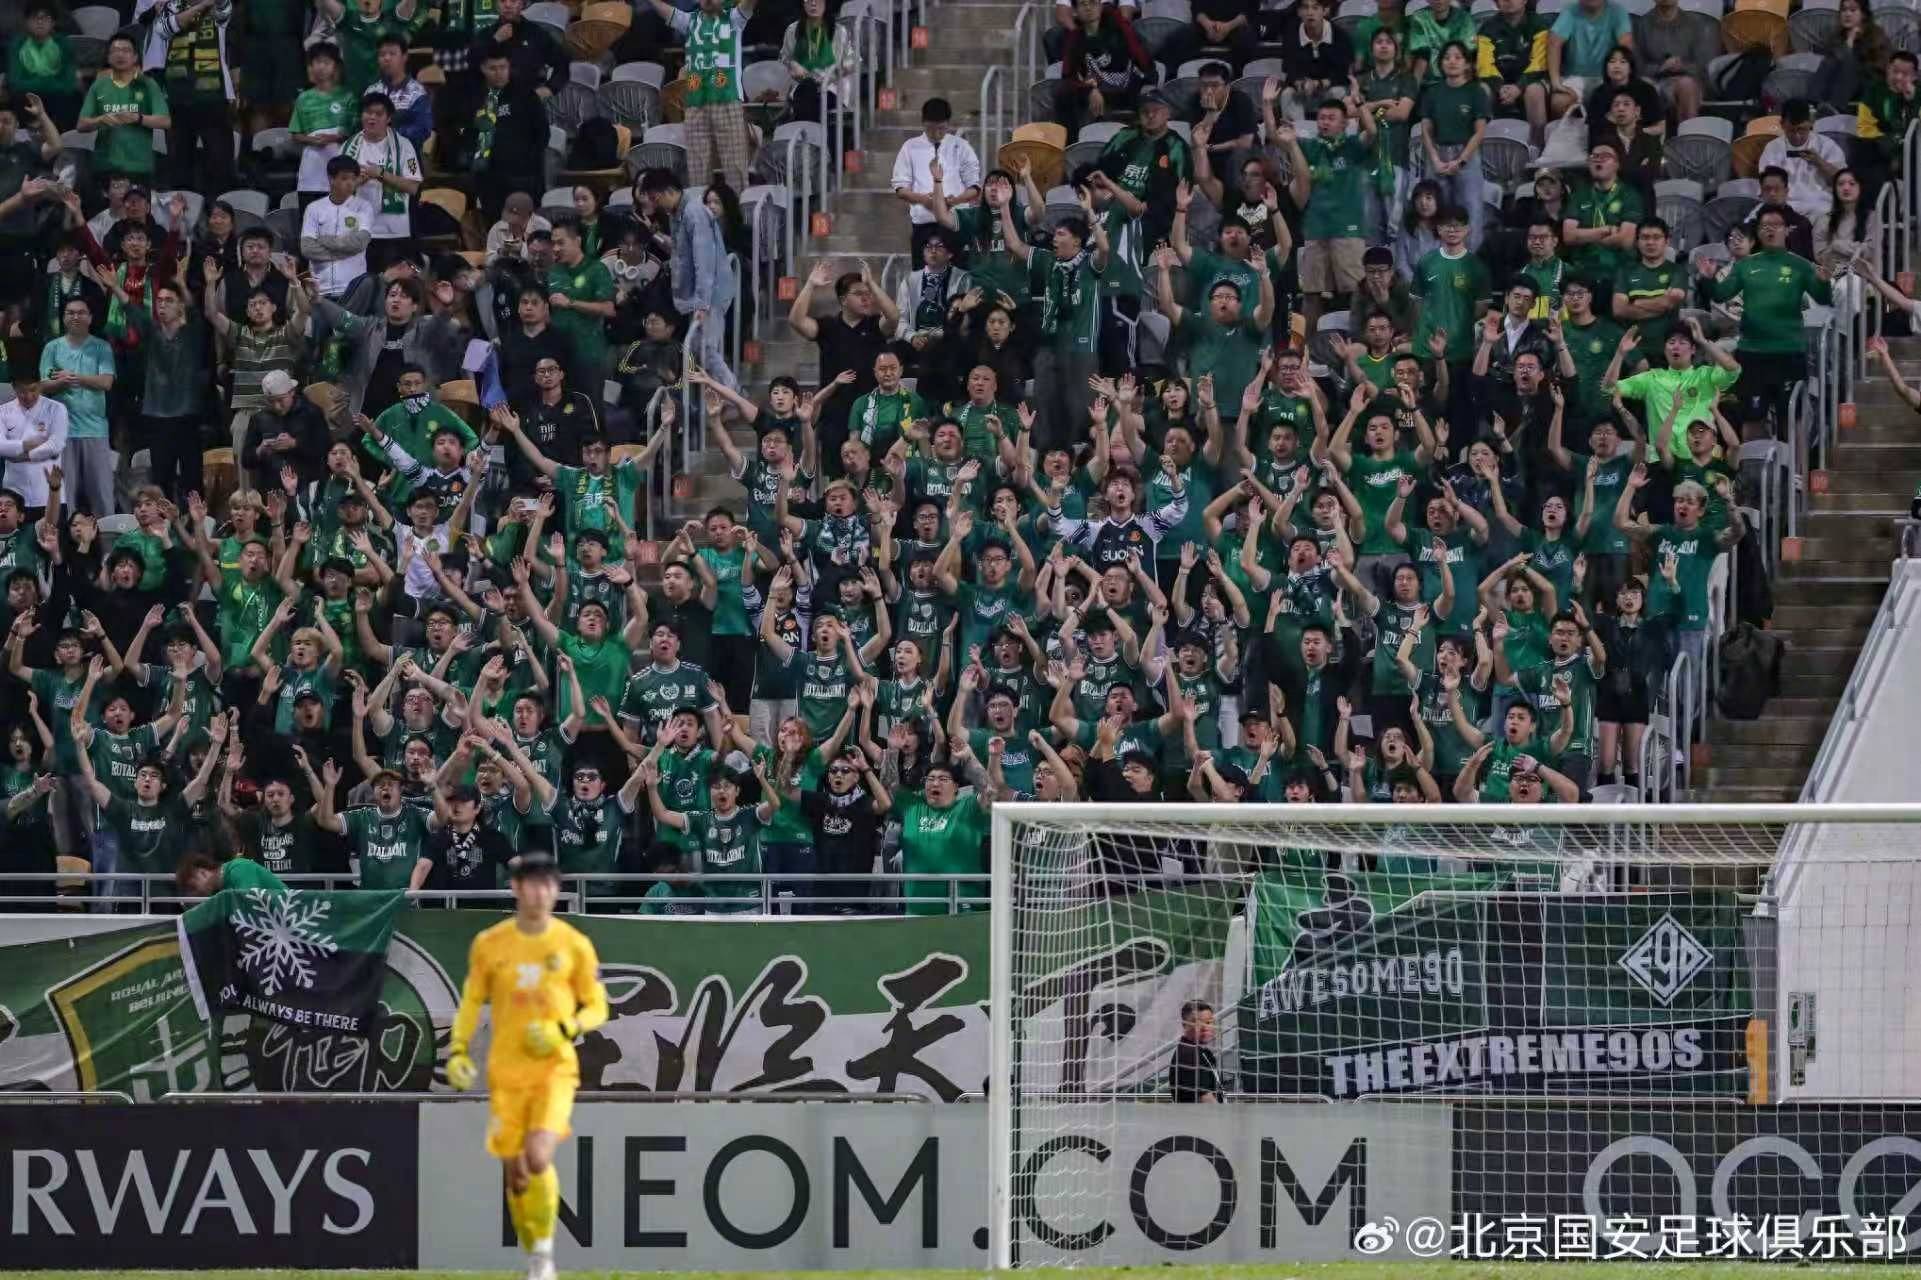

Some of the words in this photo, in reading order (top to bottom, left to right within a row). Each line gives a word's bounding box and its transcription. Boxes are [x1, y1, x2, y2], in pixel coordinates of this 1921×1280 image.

[242, 993, 294, 1020] ALWAYS
[294, 1009, 314, 1025] BE
[314, 1011, 360, 1032] THERE
[11, 1147, 375, 1235] RWAYS
